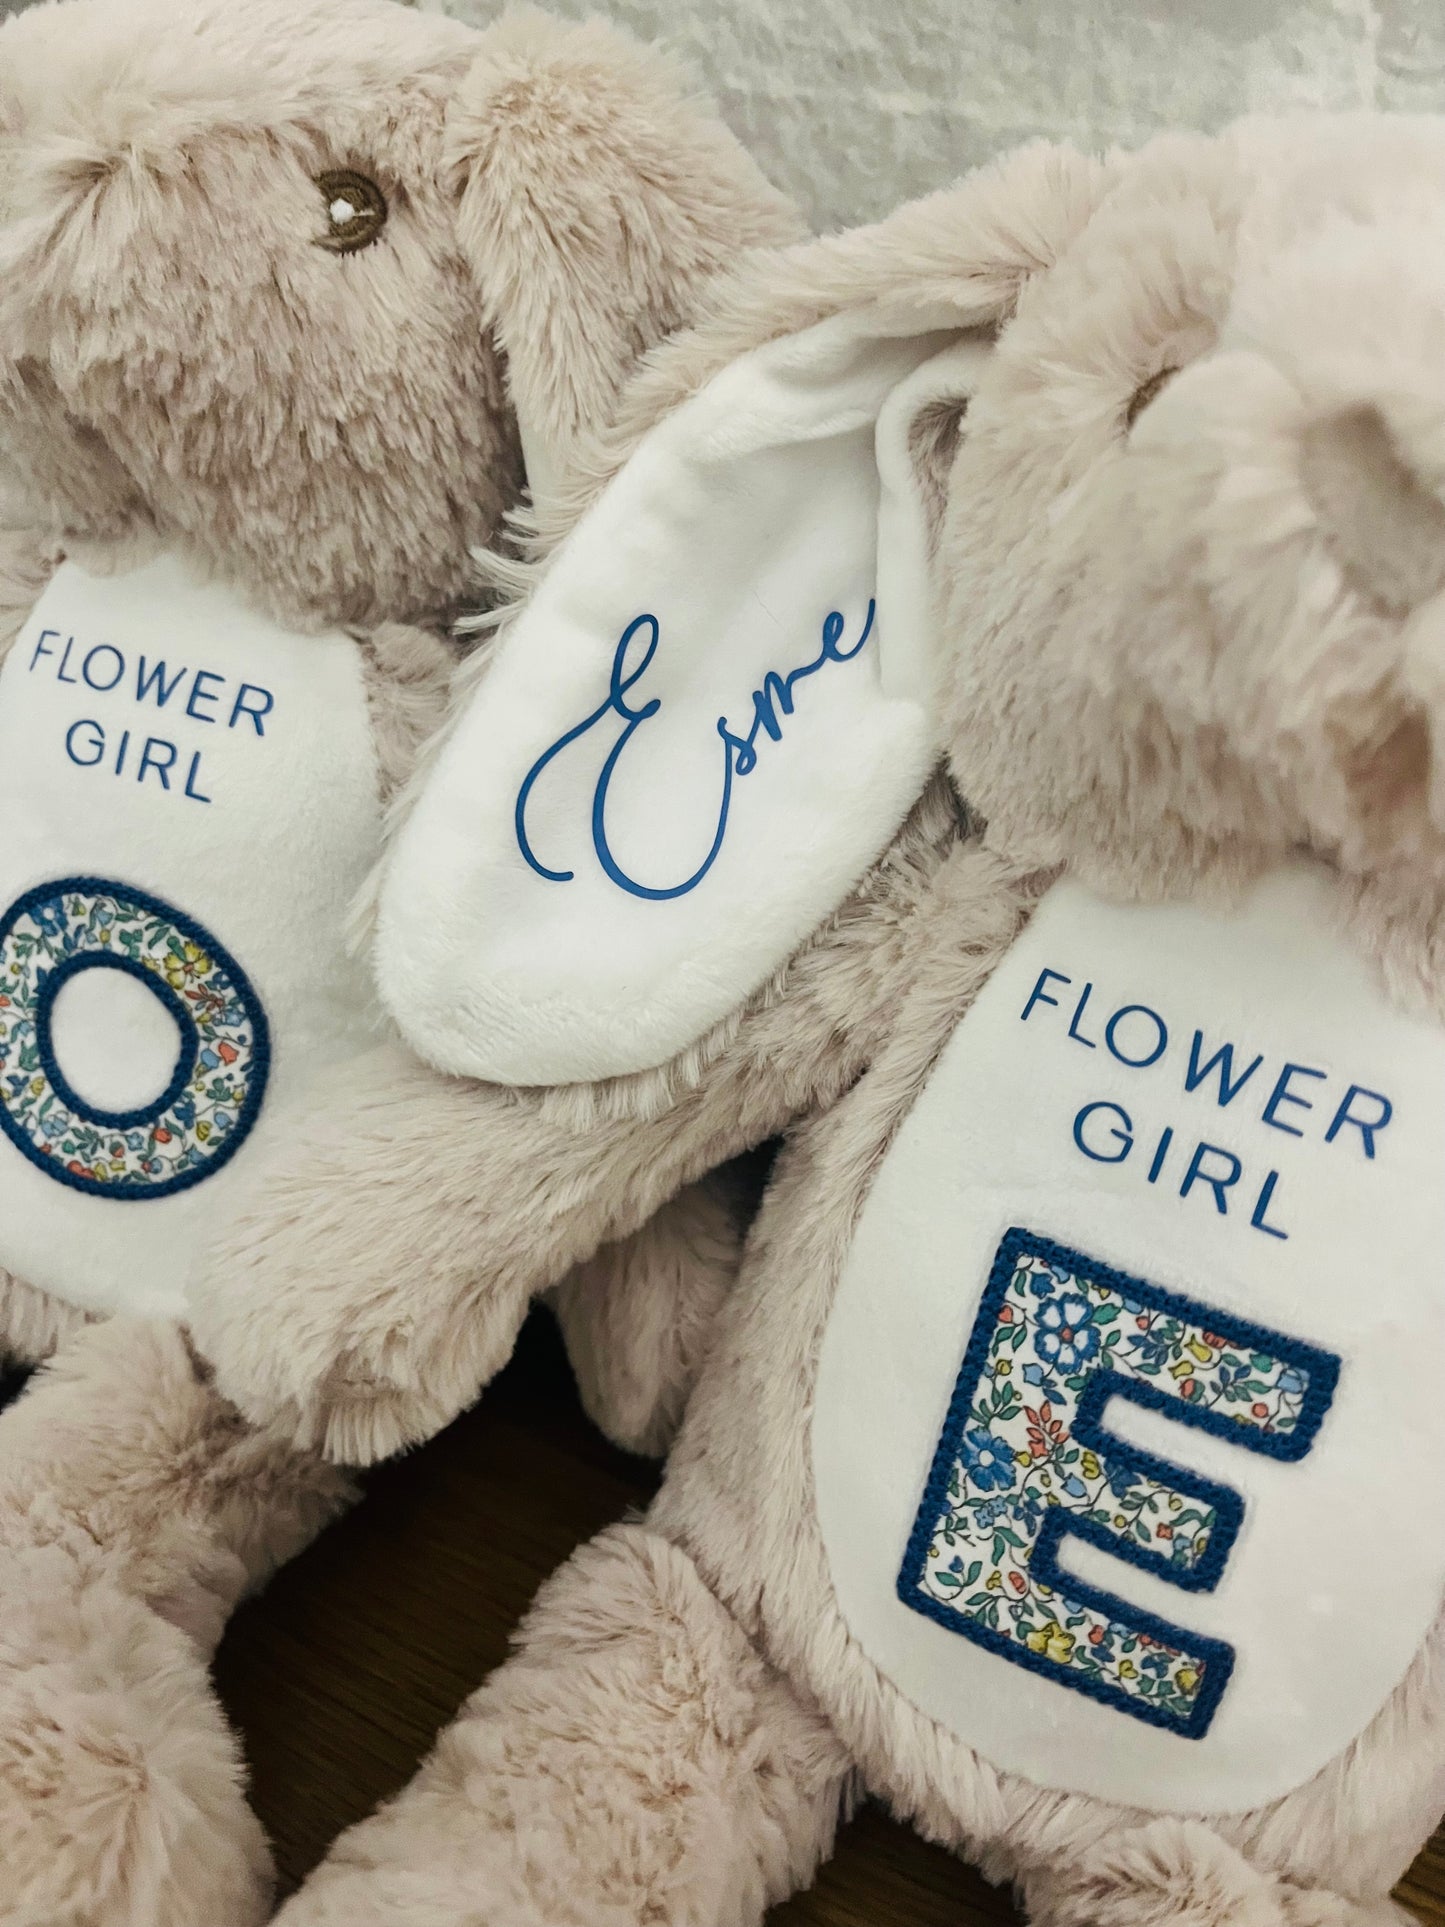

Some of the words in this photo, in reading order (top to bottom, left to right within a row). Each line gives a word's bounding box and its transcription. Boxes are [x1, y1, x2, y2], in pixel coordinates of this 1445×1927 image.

[29, 630, 274, 737] FLOWER
[65, 719, 212, 804] GIRL
[514, 598, 876, 900] Esme
[0, 876, 270, 1201] O
[1020, 968, 1394, 1161] FLOWER
[1072, 1101, 1289, 1240] GIRL
[897, 1226, 1343, 1739] E
